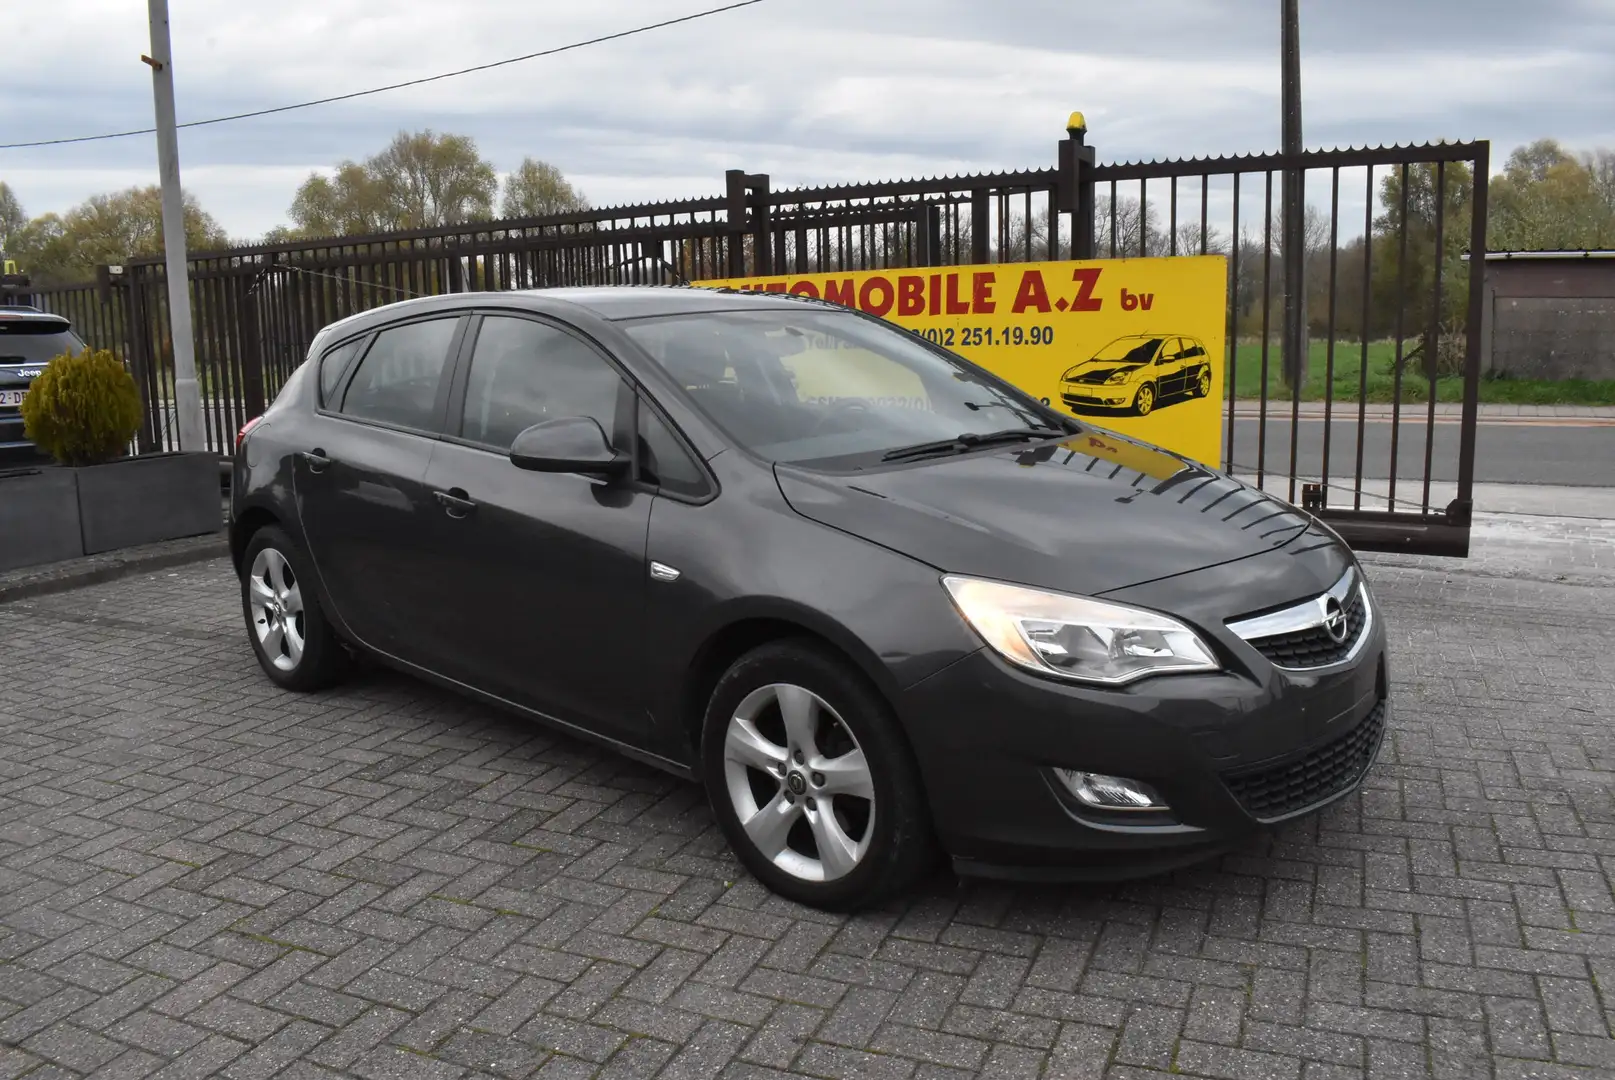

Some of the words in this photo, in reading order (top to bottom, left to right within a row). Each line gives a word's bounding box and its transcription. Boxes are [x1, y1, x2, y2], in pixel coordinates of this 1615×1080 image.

[718, 270, 997, 317] MOBILE
[1011, 267, 1103, 314] A.Z
[1120, 288, 1155, 312] bv
[960, 326, 1054, 347] 251.19.90
[17, 369, 42, 378] Jeep
